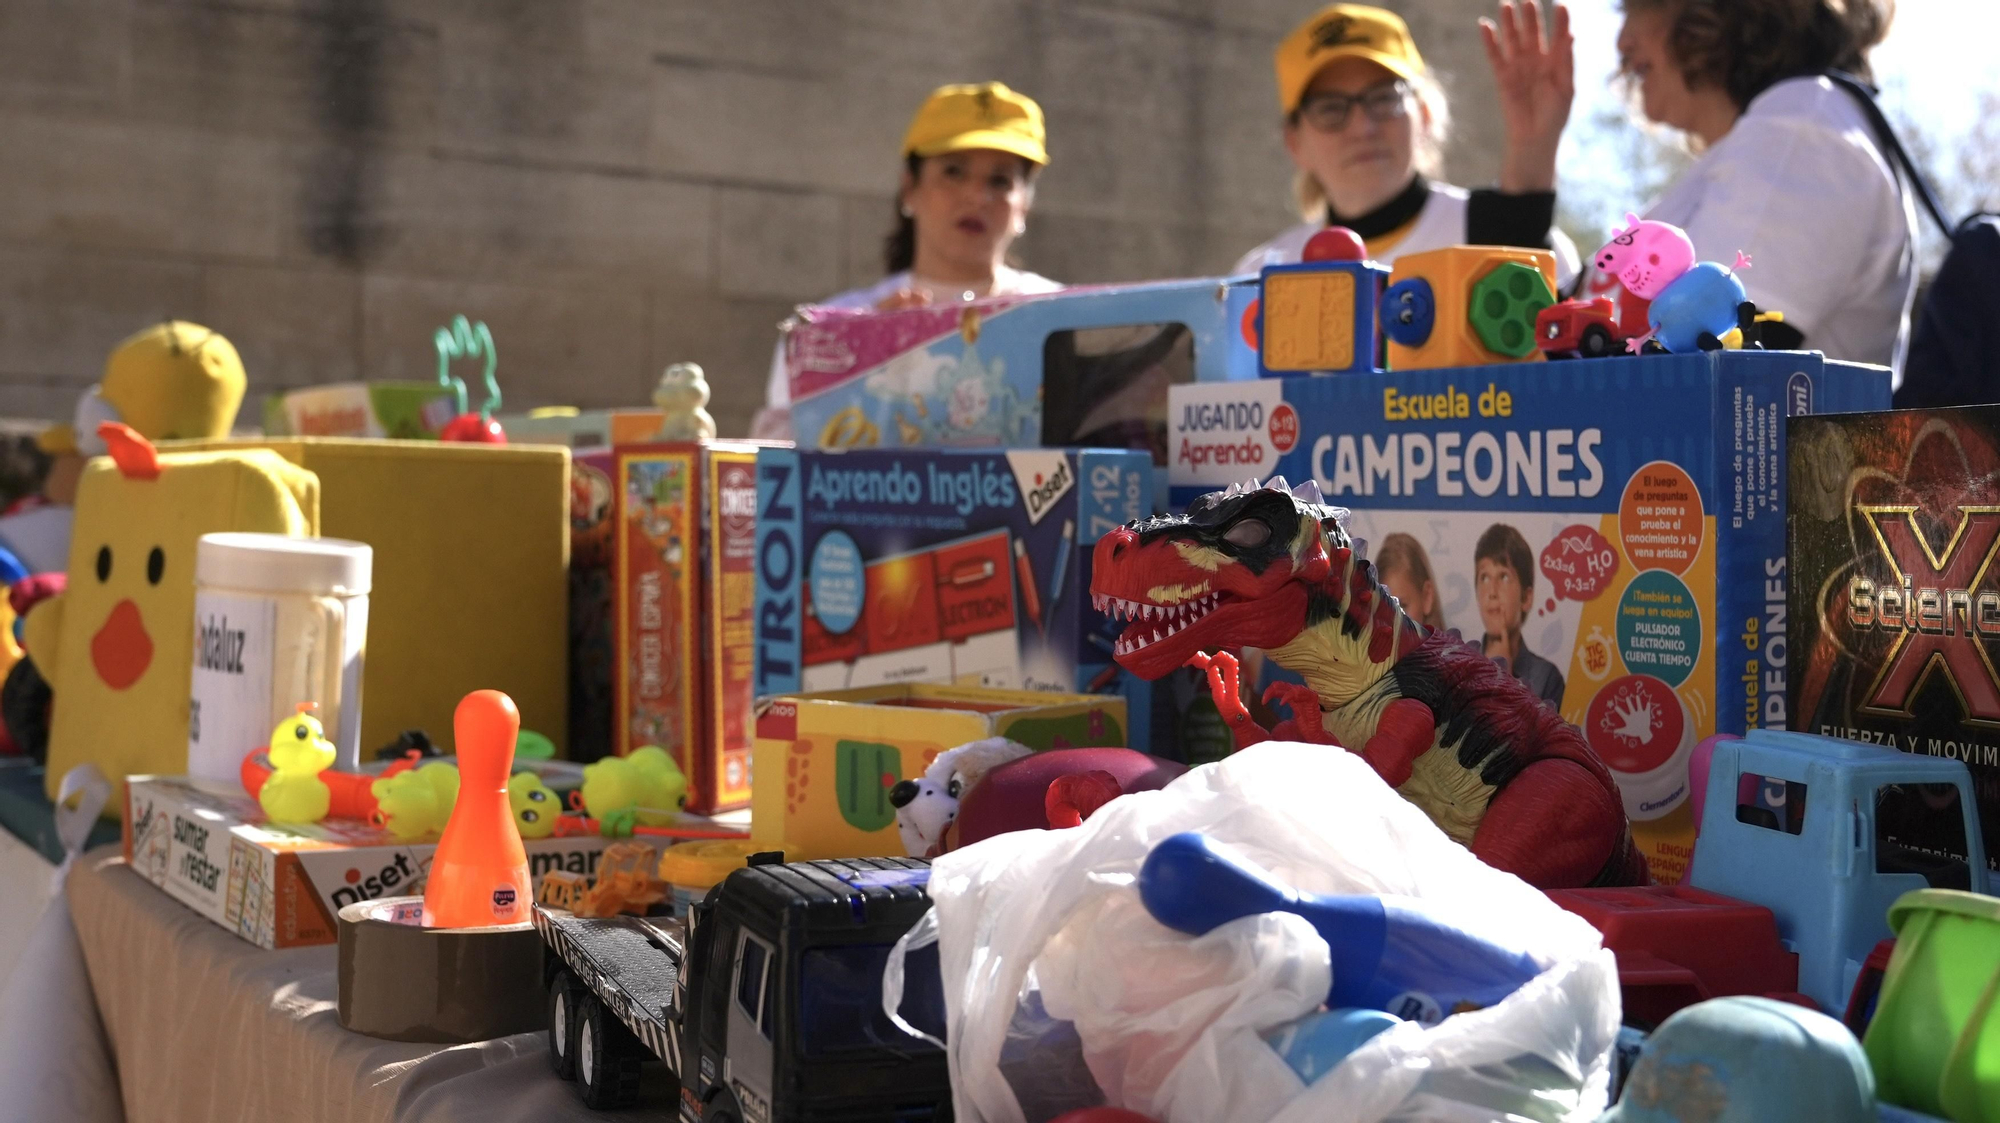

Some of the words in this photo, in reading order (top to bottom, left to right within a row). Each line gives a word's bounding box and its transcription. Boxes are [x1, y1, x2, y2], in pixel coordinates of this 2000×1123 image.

[1383, 385, 1470, 421] Escuela
[1478, 383, 1512, 417] de
[1178, 402, 1263, 432] JUGANDO
[1734, 386, 1743, 451] preguntas
[1745, 395, 1755, 441] prueba
[1178, 437, 1264, 471] Aprendo
[1747, 445, 1754, 453] a
[1758, 408, 1766, 491] conocimiento
[1311, 428, 1604, 498] CAMPEONES
[1733, 454, 1742, 472] de
[1643, 476, 1651, 487] El
[1652, 476, 1677, 488] juego
[1747, 457, 1755, 491] pone
[808, 461, 922, 509] Aprendo
[928, 459, 1015, 516] Inglés
[1027, 461, 1068, 514] Diset
[1633, 490, 1644, 500] de
[1646, 491, 1688, 502] preguntas
[1734, 476, 1743, 513] juego
[1769, 489, 1777, 501] la
[1747, 495, 1755, 520] que
[1758, 495, 1766, 507] el
[1636, 506, 1653, 516] que
[1655, 506, 1677, 516] pone
[1680, 507, 1685, 516] a
[1640, 519, 1671, 530] prueba
[1673, 519, 1681, 529] el
[1733, 517, 1742, 528] El
[1626, 533, 1679, 545] conocimiento
[1681, 536, 1686, 545] y
[1689, 534, 1697, 545] la
[1634, 549, 1654, 558] vena
[1543, 554, 1576, 574] 2x3=6
[1564, 578, 1596, 592] 9-3=?
[1672, 594, 1682, 604] se
[1622, 605, 1646, 617] juega
[1648, 606, 1659, 616] en
[1635, 622, 1681, 636] PULSADOR
[1742, 617, 1758, 650] de
[1586, 642, 1603, 657] TIC
[1630, 636, 1686, 651] ELECTRÓNICO
[1586, 655, 1605, 672] TAC
[1625, 651, 1657, 664] CUENTA
[1658, 653, 1691, 667] TIEMPO
[1907, 735, 1918, 753] Y
[174, 814, 209, 852] sumar
[187, 852, 222, 893] restar
[332, 853, 413, 911] Diset
[570, 952, 595, 985] POLICE
[596, 977, 626, 1019] TRAILER
